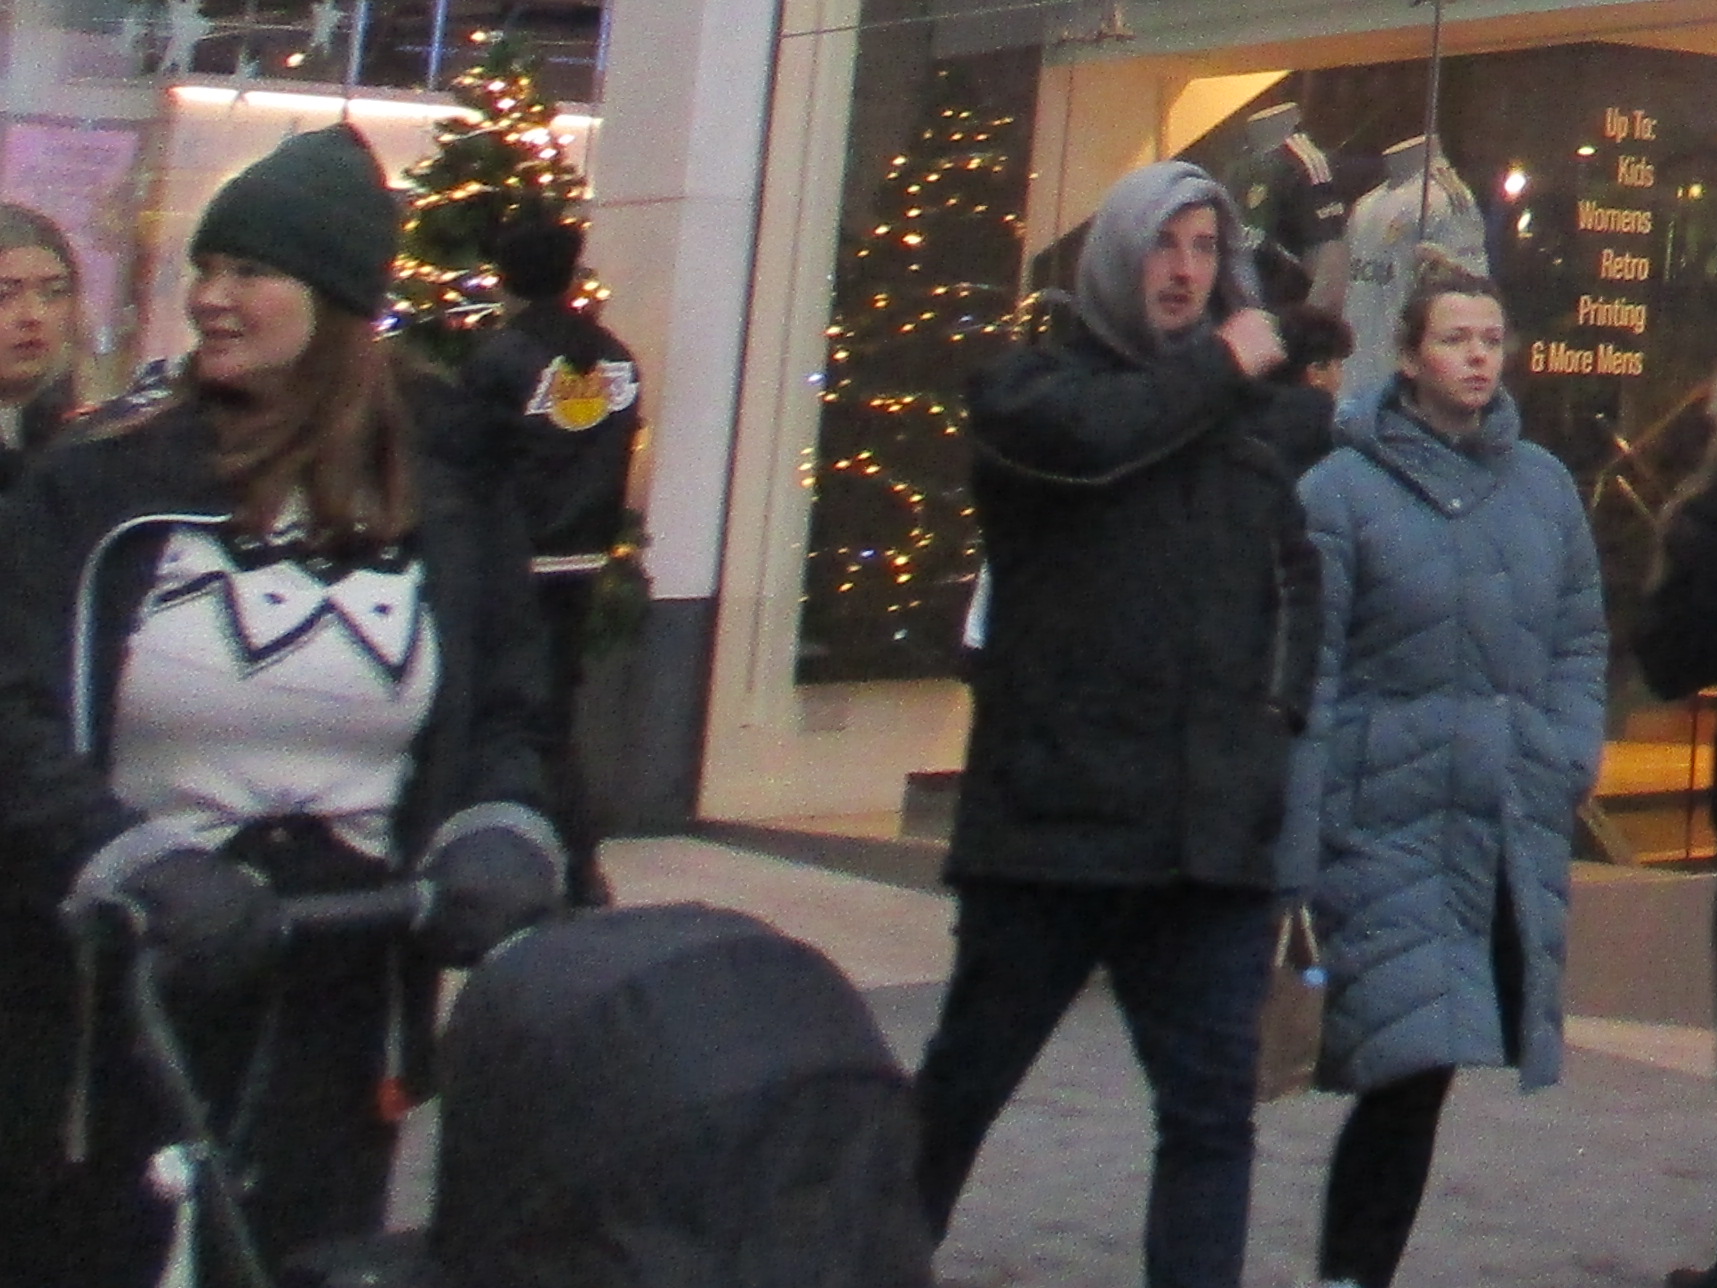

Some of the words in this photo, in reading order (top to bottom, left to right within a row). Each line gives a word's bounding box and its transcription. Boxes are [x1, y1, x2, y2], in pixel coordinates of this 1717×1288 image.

[1604, 107, 1629, 143] Up
[1617, 155, 1655, 188] Kids
[1577, 200, 1652, 235] Womens
[1601, 248, 1649, 281] Retro
[1577, 295, 1647, 335] Printing
[1530, 342, 1546, 373] &
[1547, 342, 1593, 374] More
[1597, 344, 1644, 376] Mens
